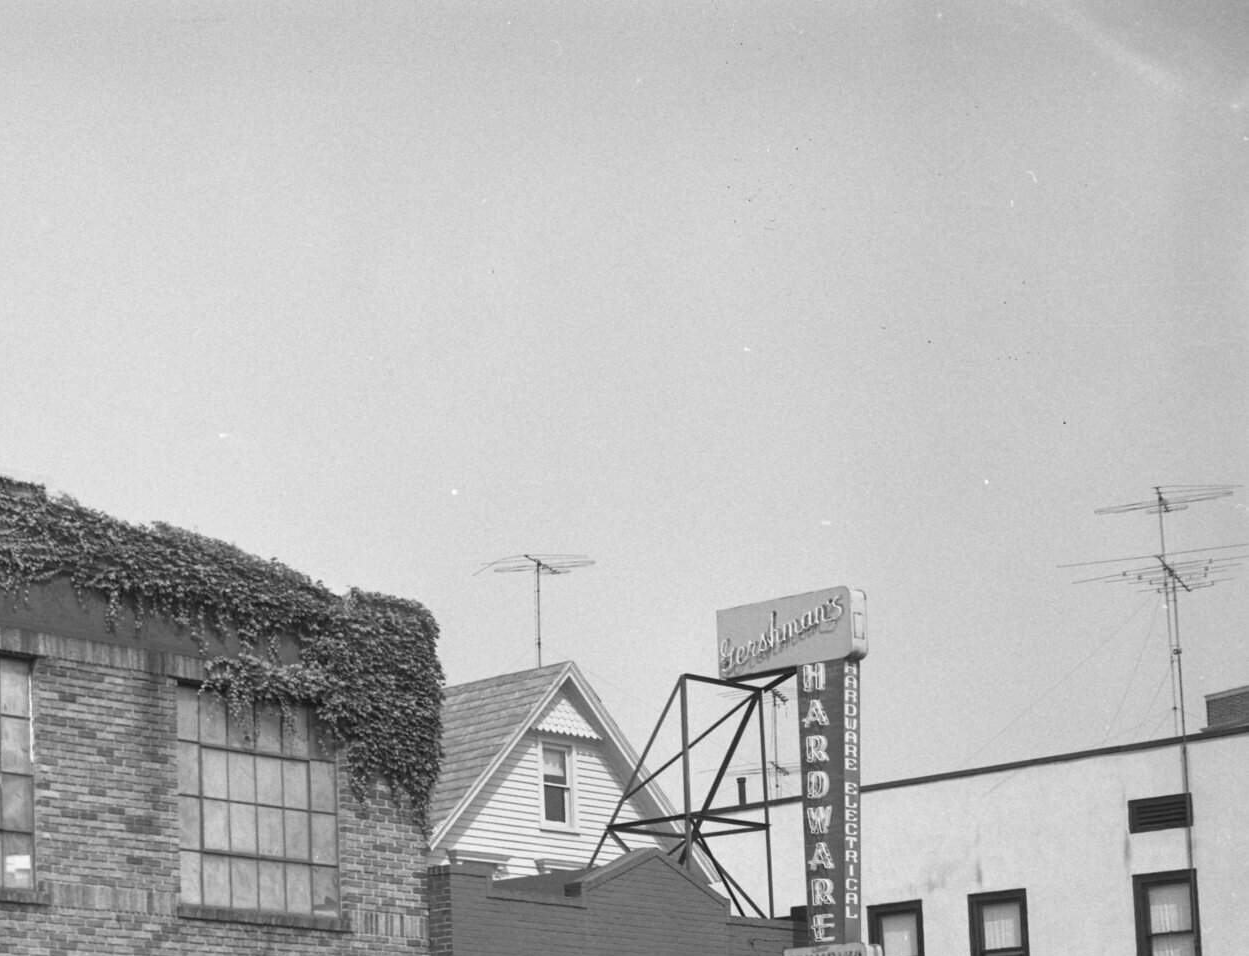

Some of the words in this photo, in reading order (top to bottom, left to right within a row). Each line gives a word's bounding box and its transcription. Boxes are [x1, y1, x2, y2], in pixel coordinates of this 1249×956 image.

[720, 595, 843, 673] Gershman's
[844, 660, 858, 771] HARDWARE
[802, 662, 837, 943] HARDWARE
[844, 781, 858, 919] ELECTRICAL
